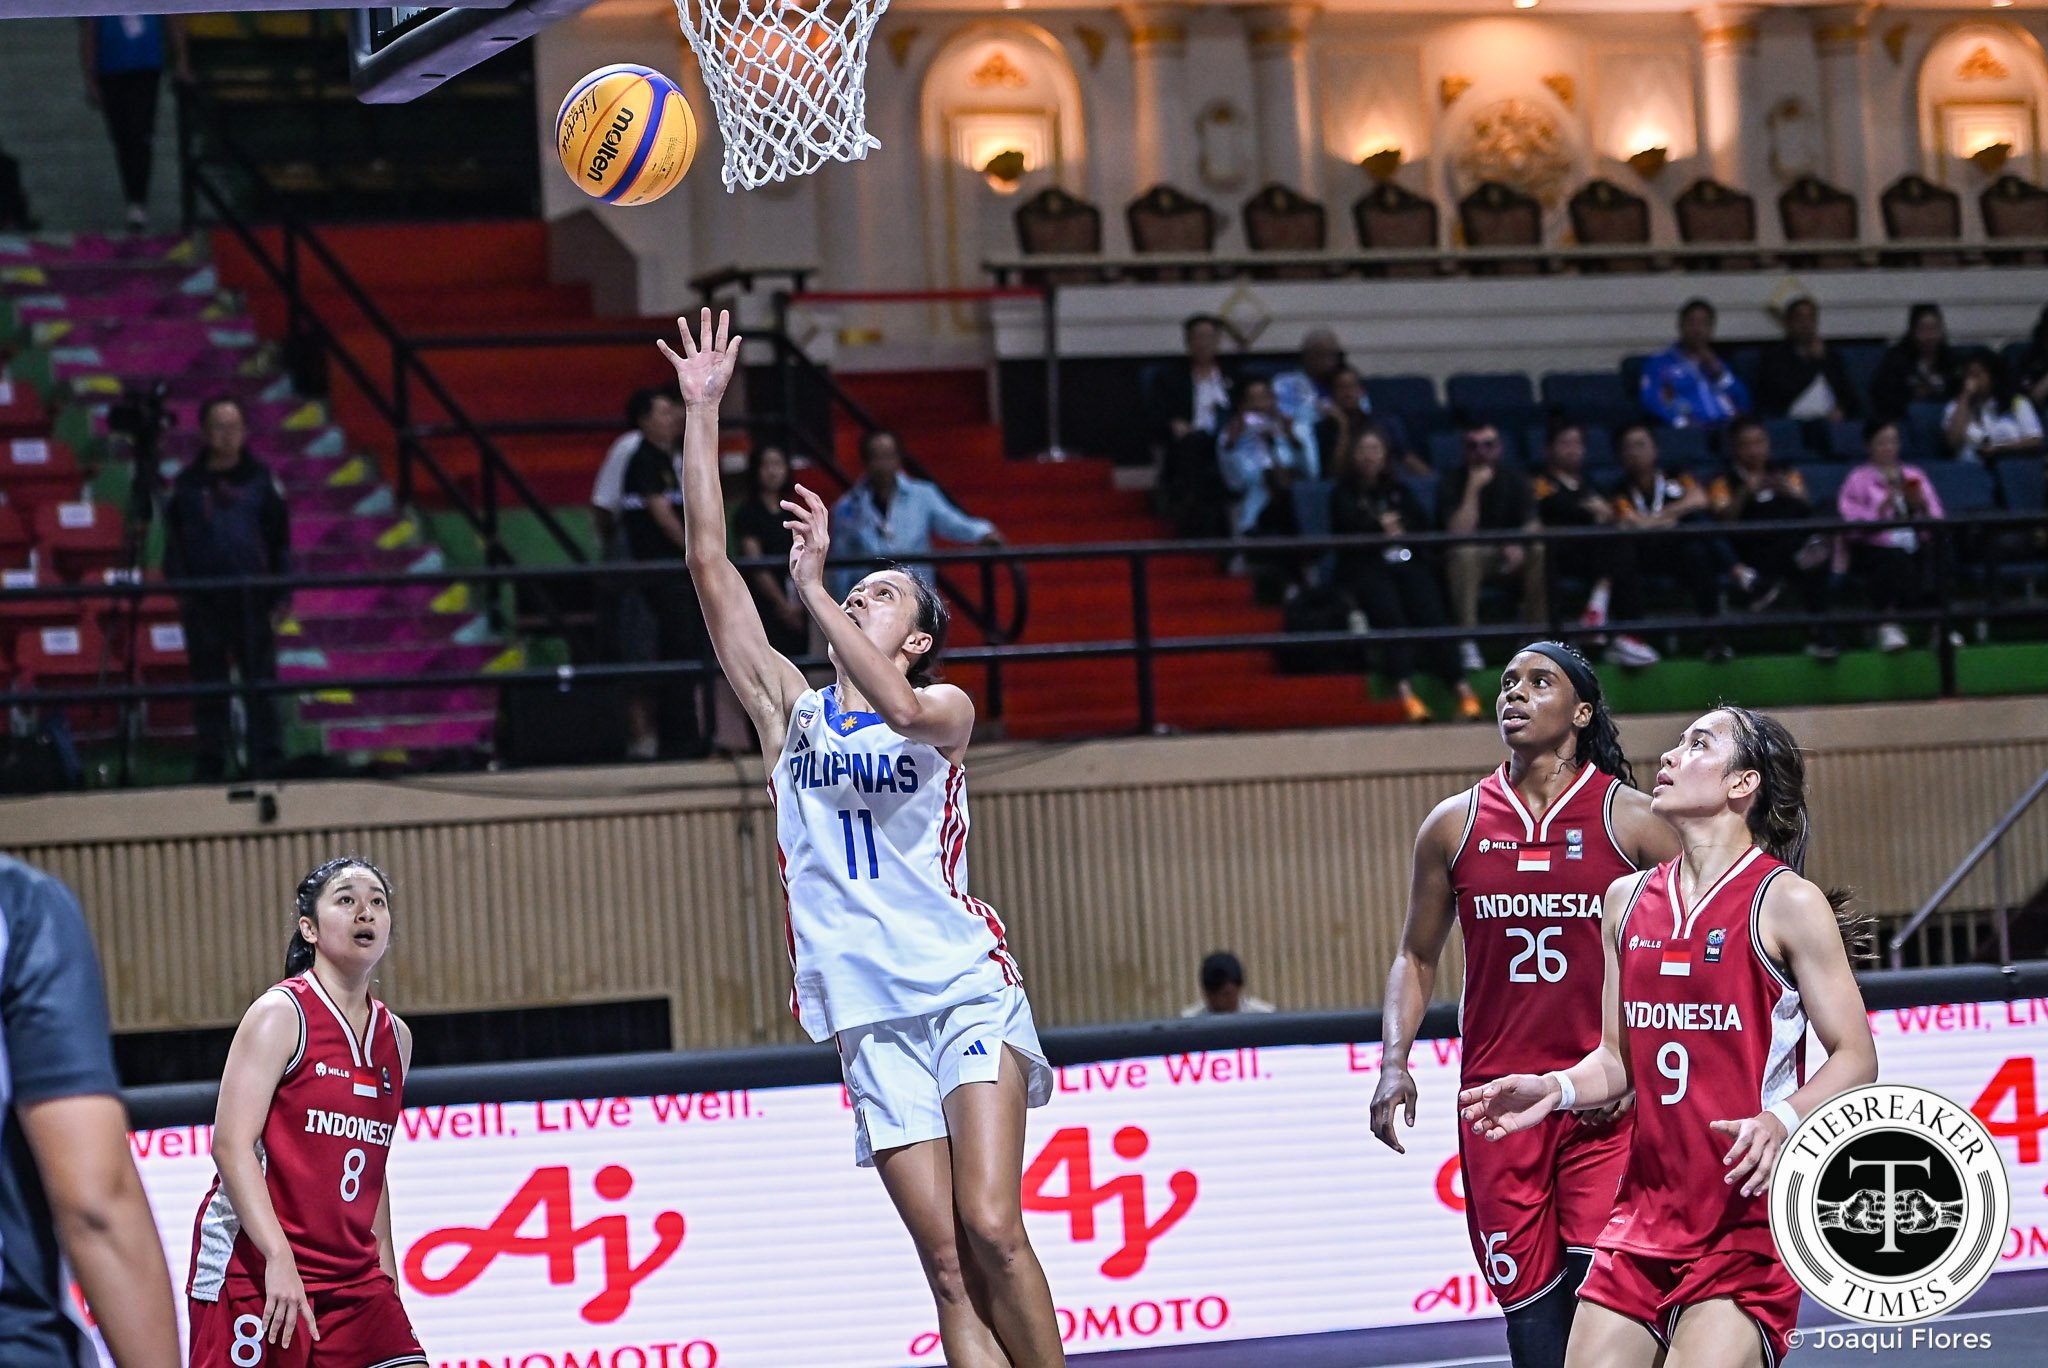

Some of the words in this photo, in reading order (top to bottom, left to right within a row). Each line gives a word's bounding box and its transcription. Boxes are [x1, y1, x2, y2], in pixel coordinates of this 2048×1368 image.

[586, 107, 634, 182] molten
[789, 751, 919, 793] PILIPINAS
[838, 809, 879, 879] 11
[1492, 841, 1518, 850] MILLS
[1473, 893, 1603, 919] INDONESIA
[1505, 926, 1568, 983] 26
[1638, 939, 1662, 949] MILLS
[1623, 1001, 1743, 1032] NDONESIA
[1059, 1061, 1148, 1093] Live
[1656, 1041, 1689, 1105] 9
[536, 1097, 632, 1133] Live
[340, 1148, 366, 1202] 8
[230, 1313, 266, 1367] 8
